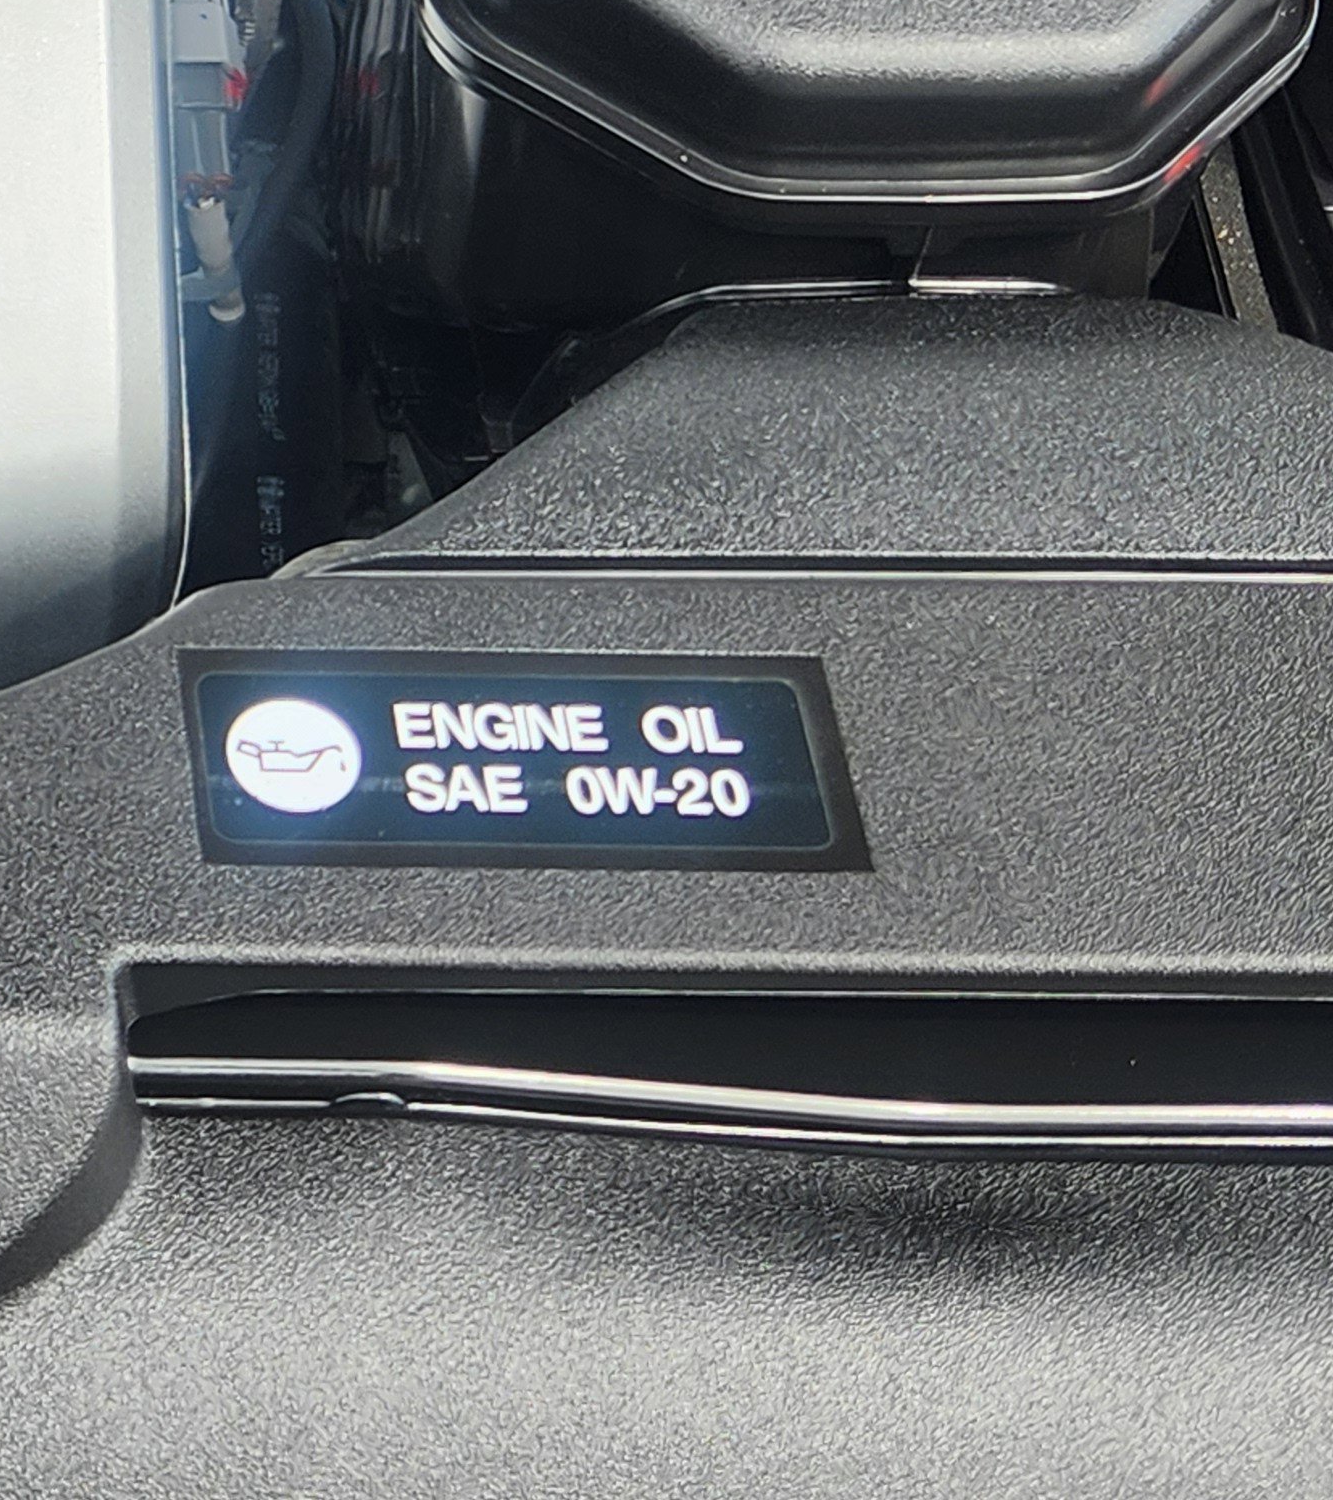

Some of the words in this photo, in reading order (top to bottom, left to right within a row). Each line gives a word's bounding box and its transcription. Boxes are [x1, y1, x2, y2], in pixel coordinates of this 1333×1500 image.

[393, 701, 610, 753] ENGINE
[641, 704, 744, 755] OIL
[404, 763, 529, 814] SAE
[564, 766, 751, 818] 0W-20
